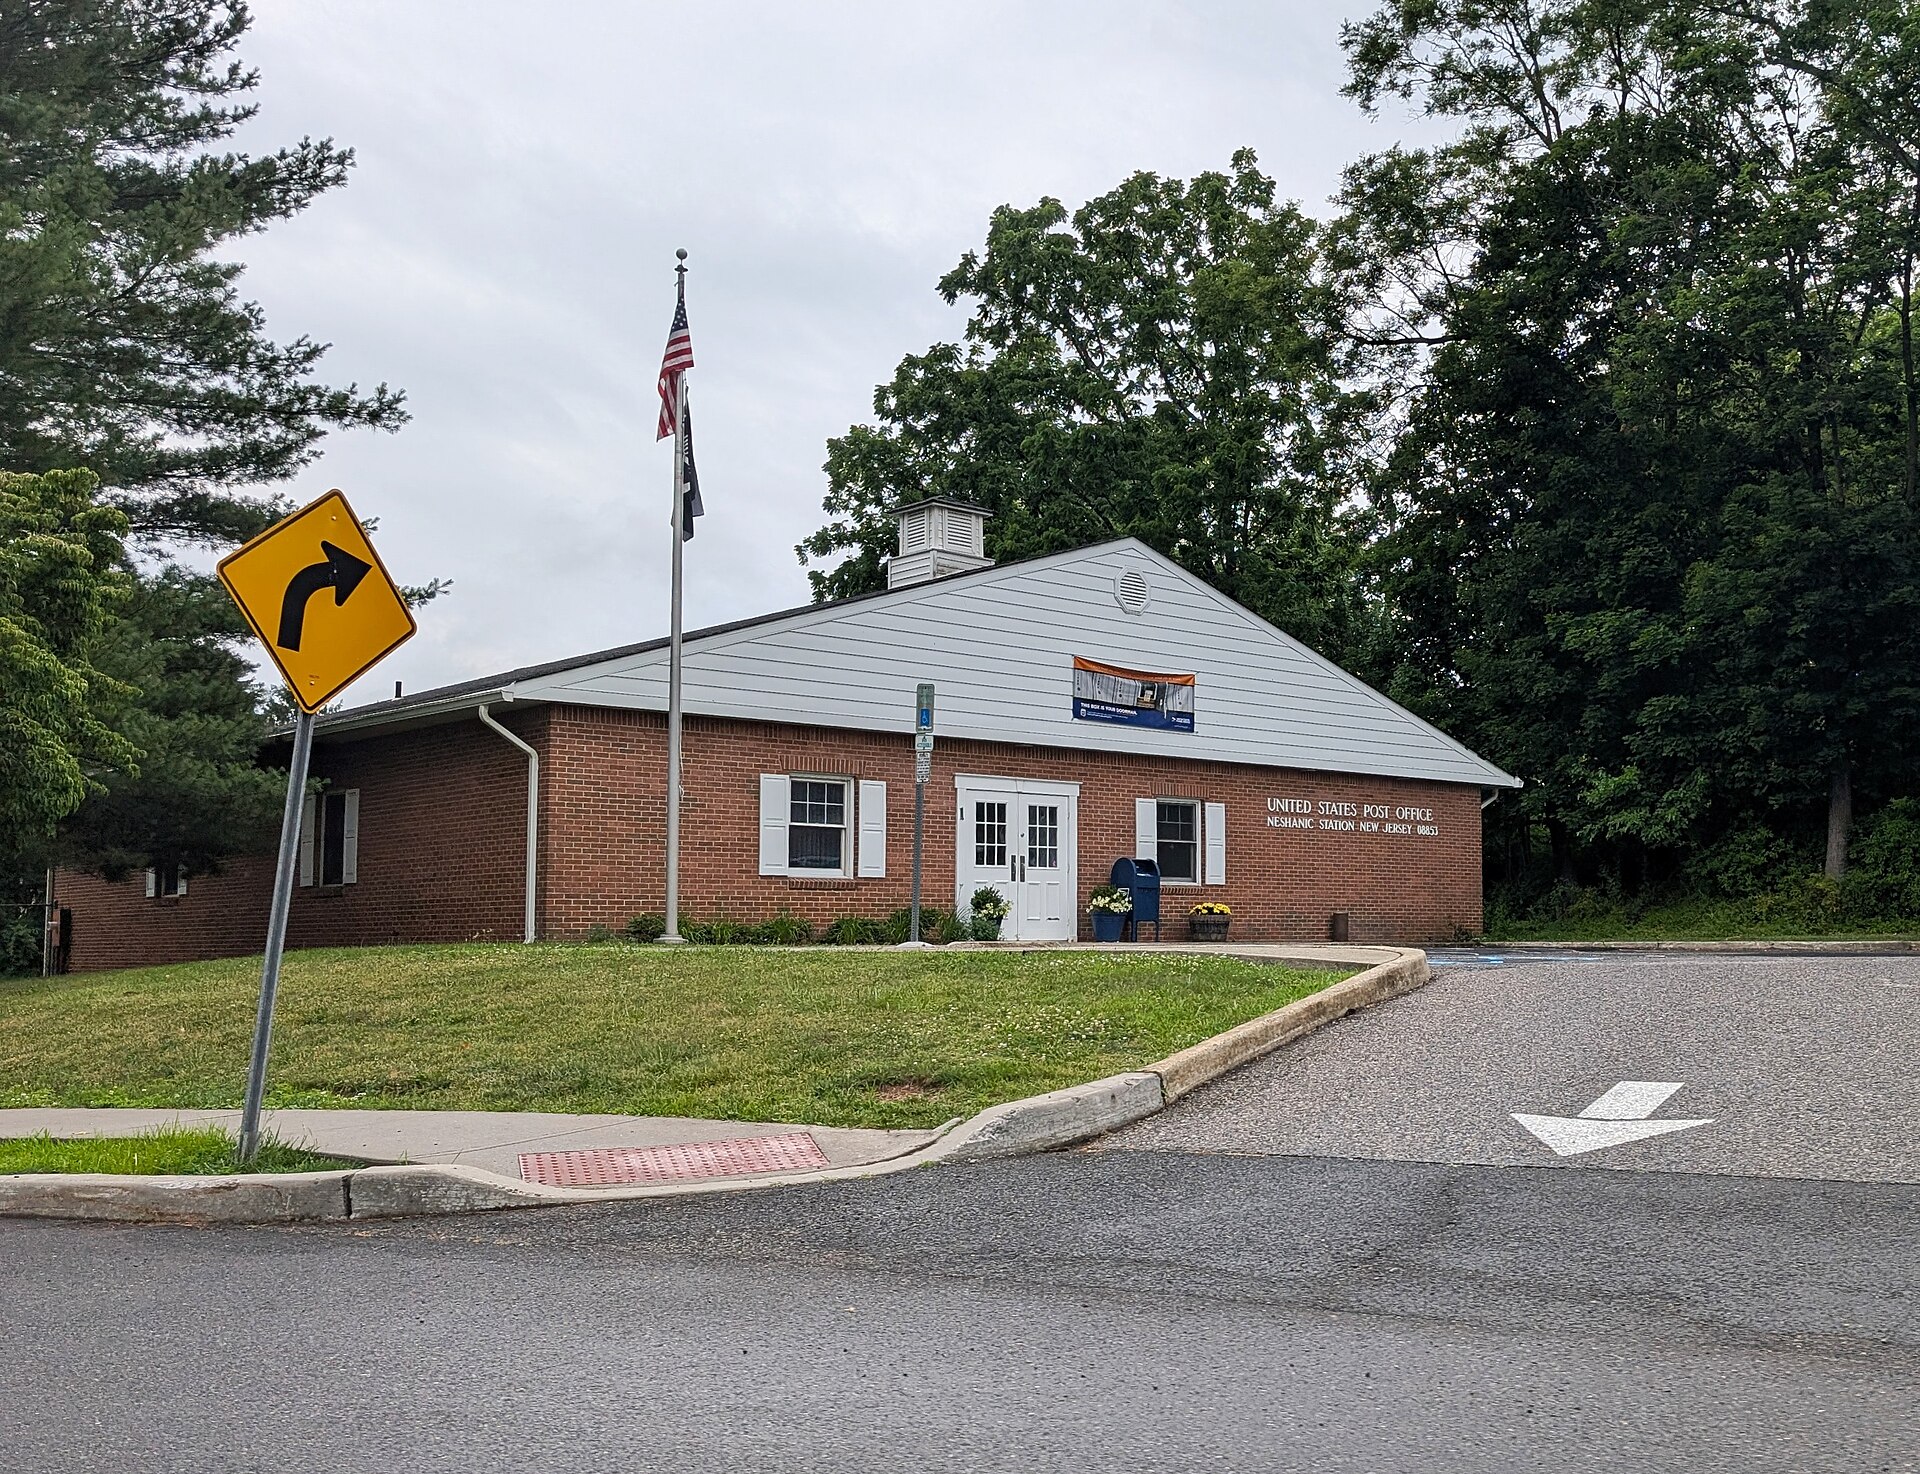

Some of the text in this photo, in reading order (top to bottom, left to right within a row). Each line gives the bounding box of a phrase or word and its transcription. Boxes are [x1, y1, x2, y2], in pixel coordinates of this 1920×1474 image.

[1267, 797, 1434, 822] UNITED STATES POST OFFICE
[1267, 815, 1439, 836] NESHANIC STATION NEW JERSEY 08853
